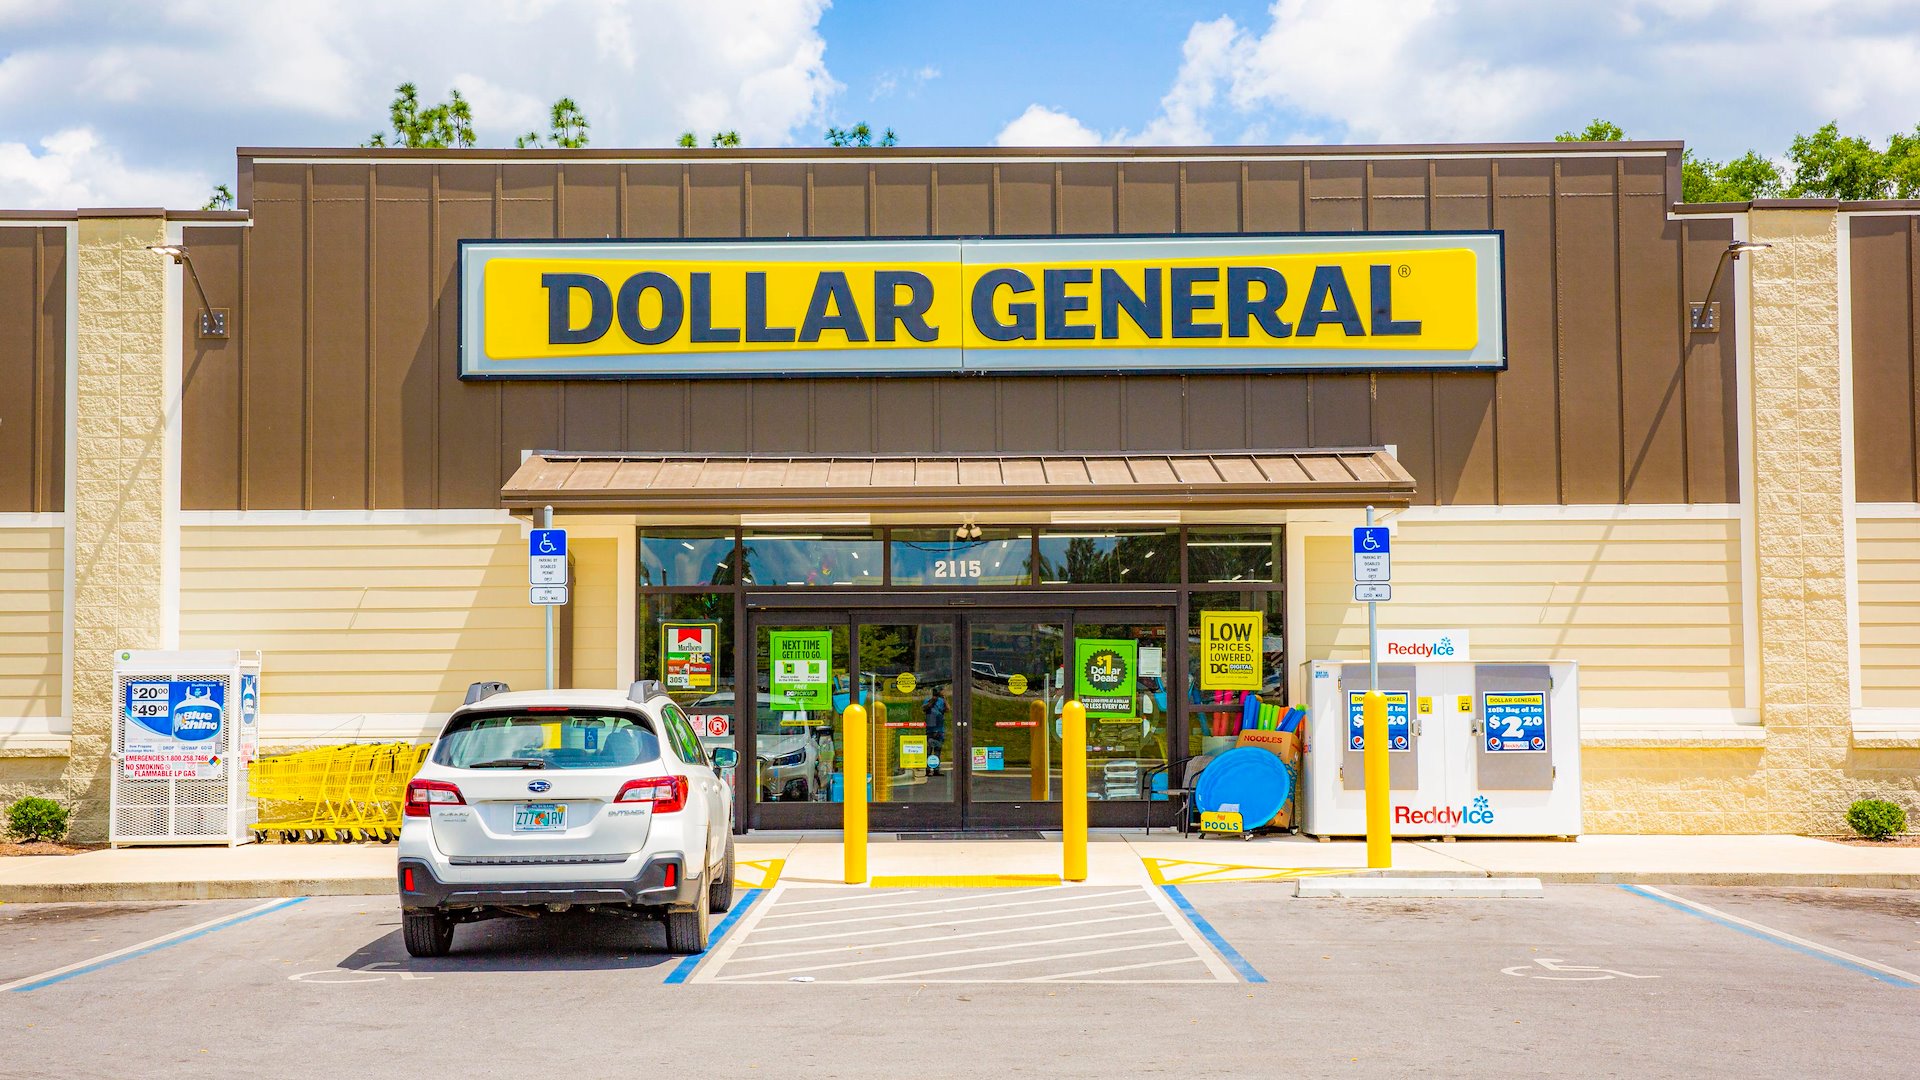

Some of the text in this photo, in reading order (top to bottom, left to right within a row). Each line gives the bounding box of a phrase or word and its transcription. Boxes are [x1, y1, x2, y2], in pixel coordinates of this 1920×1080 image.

[542, 271, 939, 345] DOLLAR
[971, 265, 1422, 342] GENERAL
[934, 560, 981, 578] 2115
[1210, 623, 1252, 641] LOW
[677, 642, 702, 651] Marlboro
[782, 640, 820, 650] NEXT TIME
[1210, 643, 1254, 653] PRICES,
[782, 651, 822, 659] GET IT TO GO.
[1210, 653, 1254, 662] LOWERED.
[1210, 664, 1228, 674] DG
[669, 676, 688, 684] 305's
[1093, 674, 1118, 682] Deals
[1505, 706, 1520, 714] Bag
[184, 711, 213, 720] Blue
[713, 721, 723, 731] R
[1244, 735, 1282, 744] NOODLES
[1204, 821, 1239, 831] POOLS
